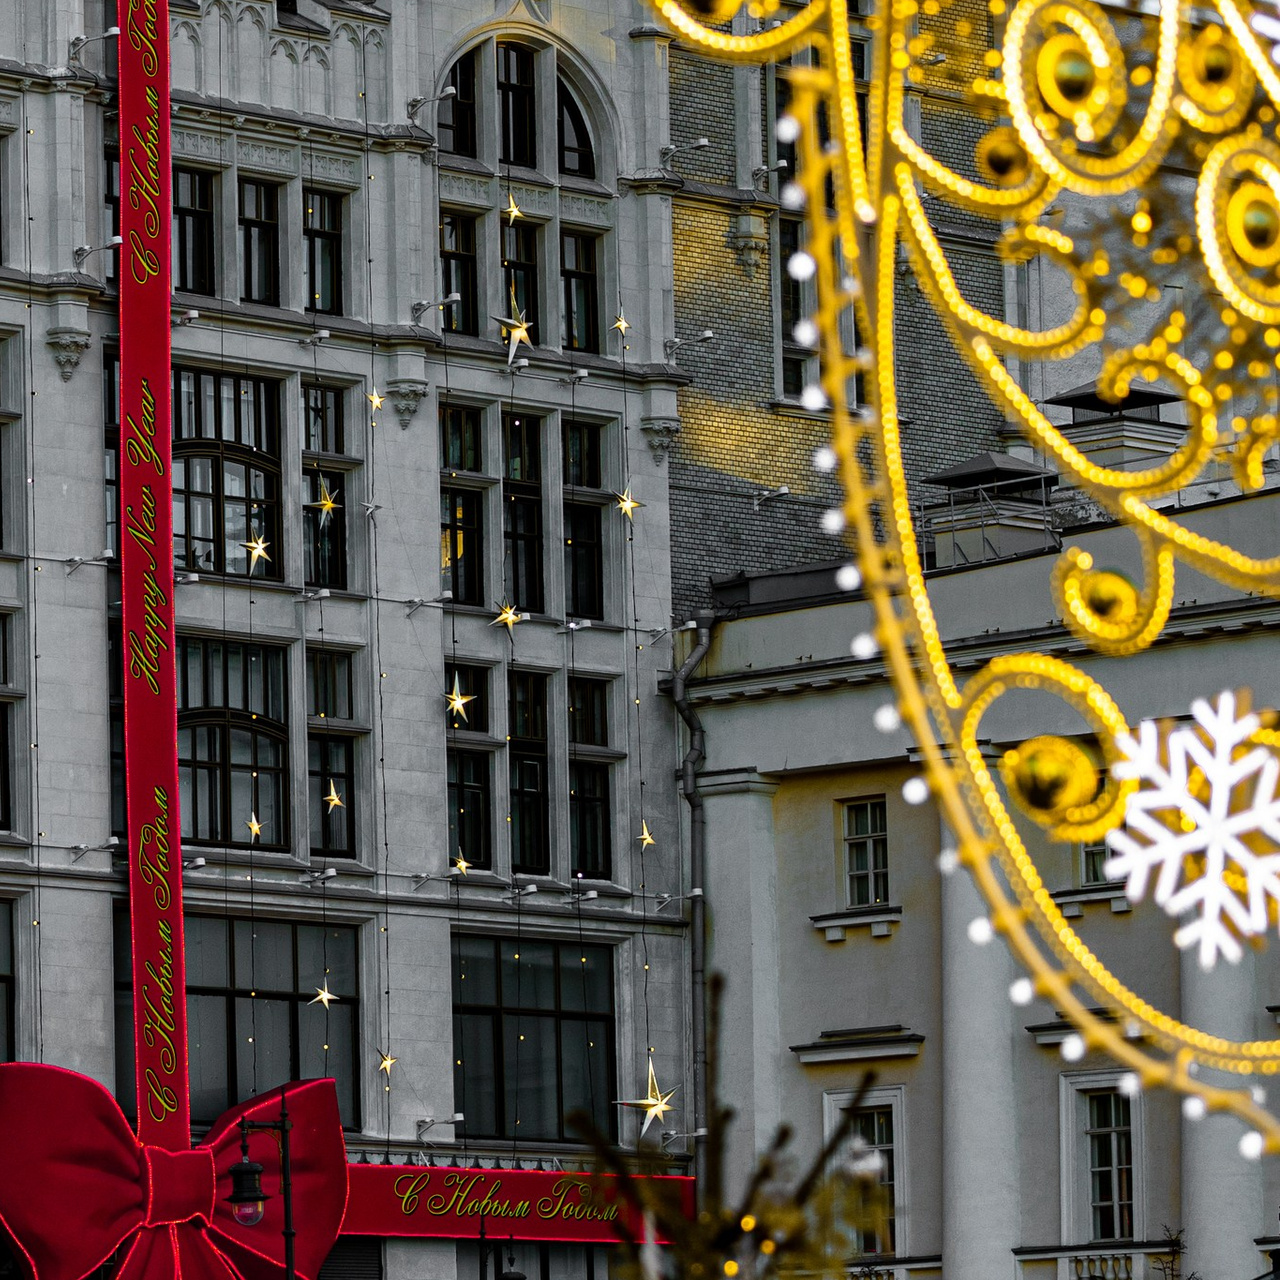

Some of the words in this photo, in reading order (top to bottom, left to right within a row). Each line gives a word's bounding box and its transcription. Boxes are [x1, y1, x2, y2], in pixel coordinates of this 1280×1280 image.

[128, 85, 162, 241] Новым
[126, 378, 165, 476] Year
[125, 486, 159, 571] New
[129, 571, 166, 696] Happy
[137, 785, 172, 912] Годом
[143, 918, 178, 1076] Новым
[427, 1173, 531, 1219] Новым
[536, 1178, 620, 1222] Годом
